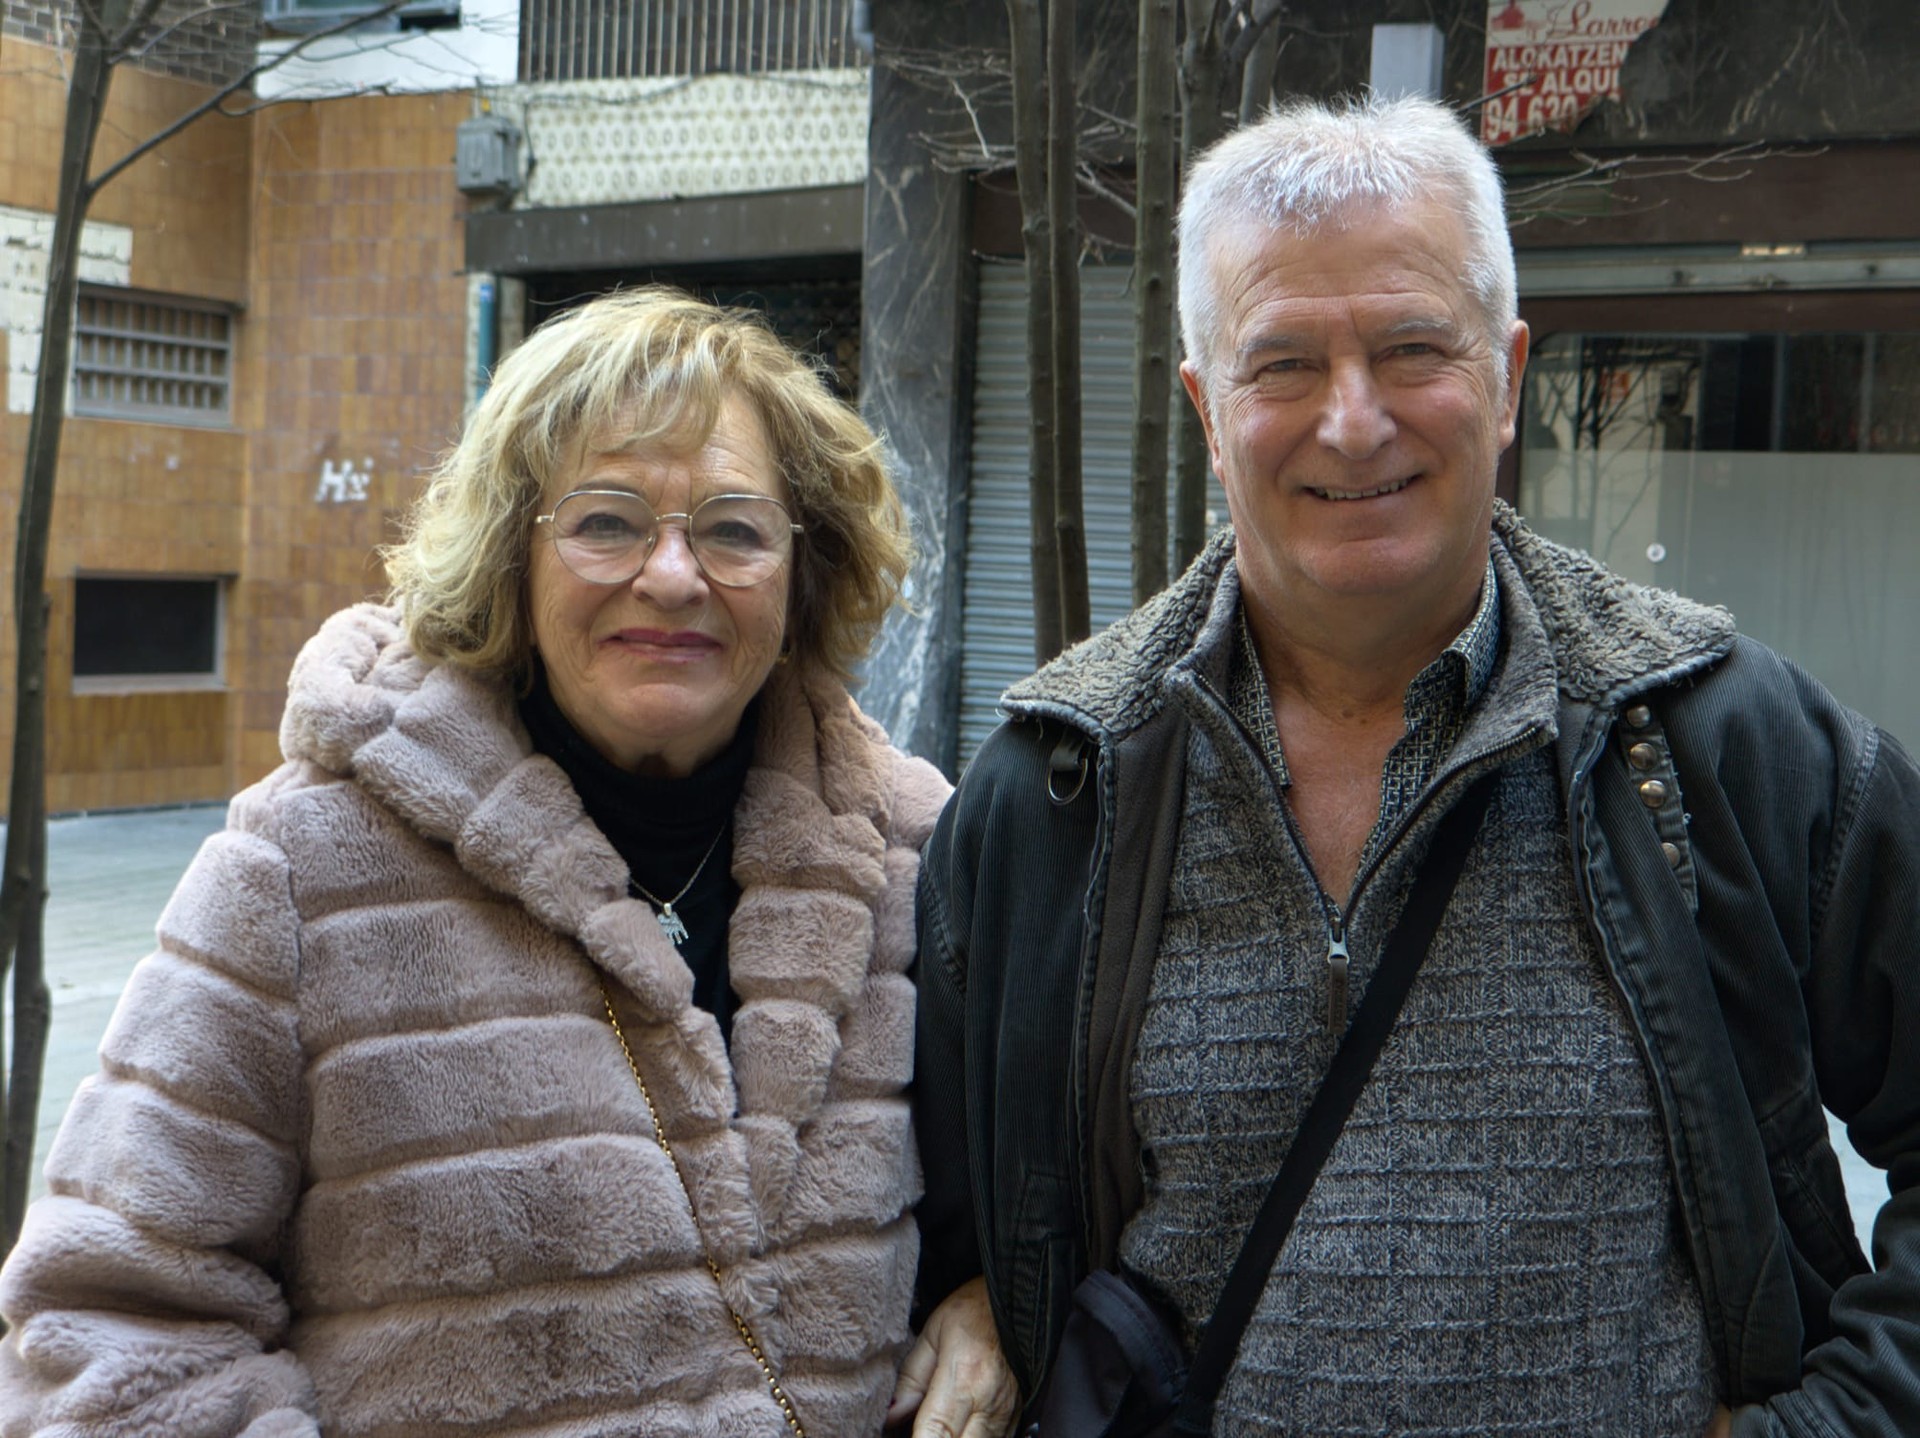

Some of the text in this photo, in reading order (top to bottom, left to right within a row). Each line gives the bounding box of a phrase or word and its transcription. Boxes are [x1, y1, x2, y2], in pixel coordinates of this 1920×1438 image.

[1493, 41, 1628, 72] ALOKATZEN
[1503, 72, 1534, 96] SE
[1486, 97, 1518, 141] 94
